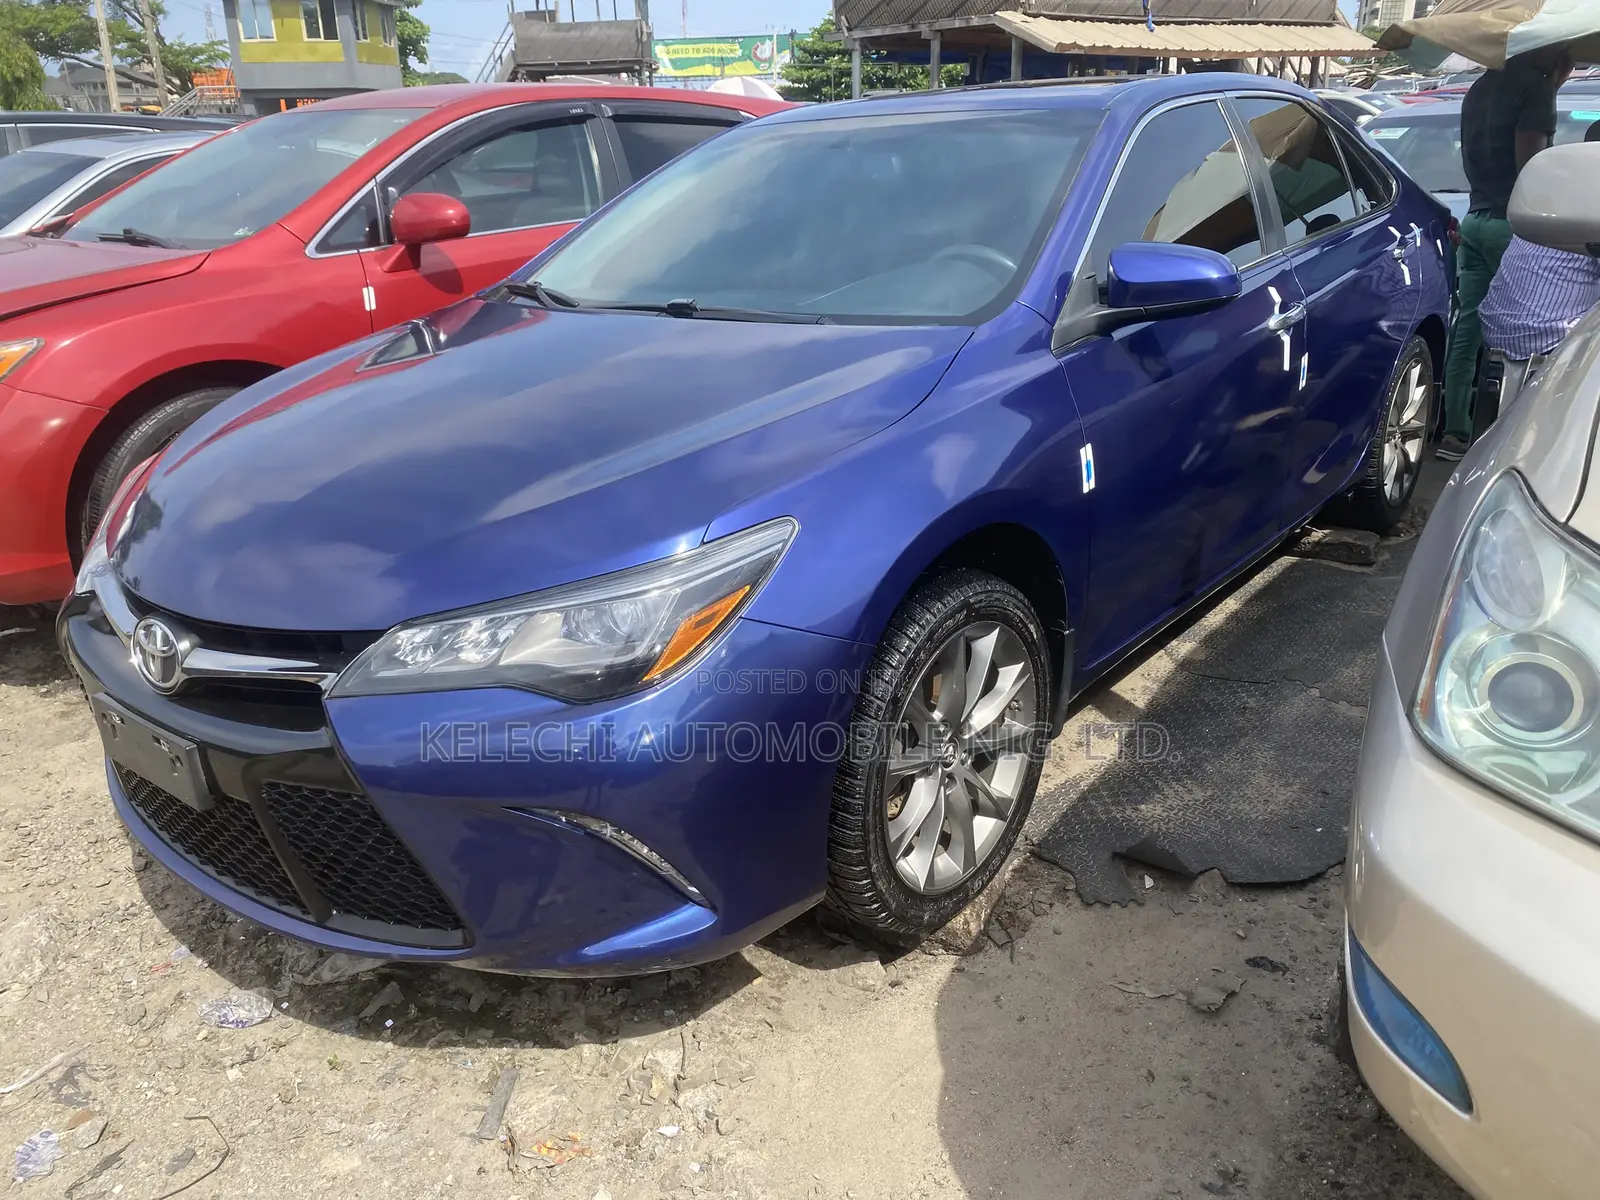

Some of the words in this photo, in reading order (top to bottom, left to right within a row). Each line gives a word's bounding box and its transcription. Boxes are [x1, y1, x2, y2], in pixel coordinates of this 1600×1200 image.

[671, 47, 690, 56] NEED
[691, 47, 701, 55] TO
[702, 46, 716, 55] ADD
